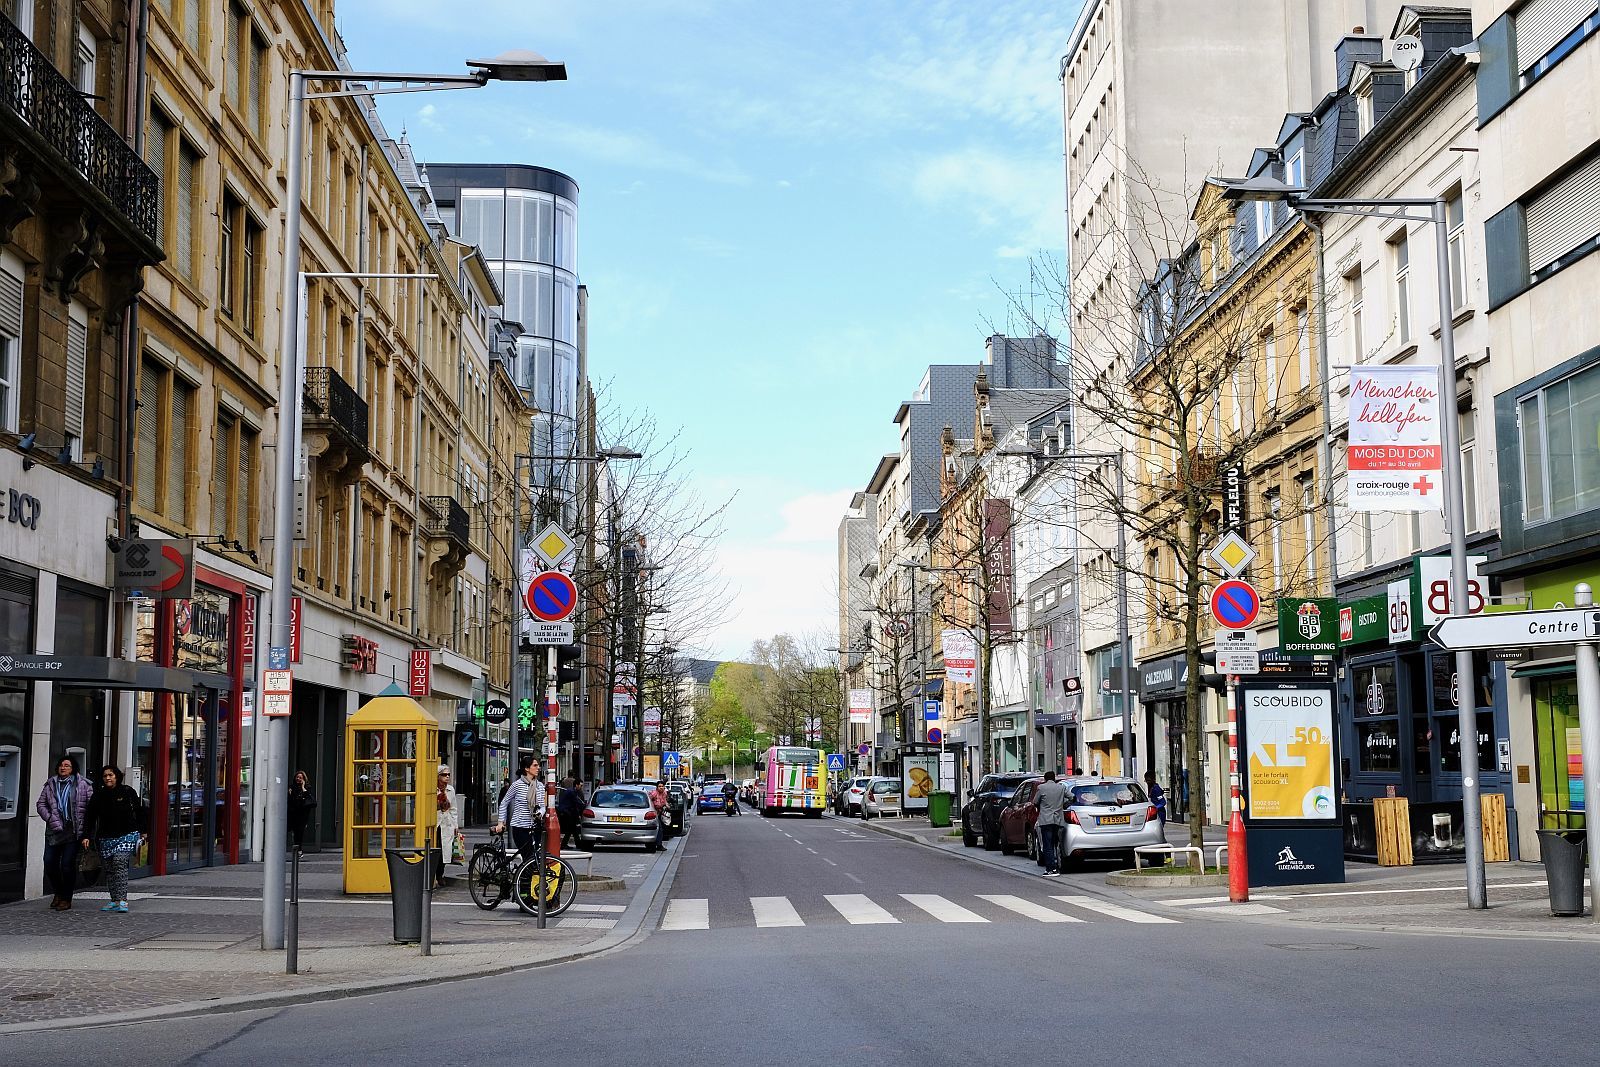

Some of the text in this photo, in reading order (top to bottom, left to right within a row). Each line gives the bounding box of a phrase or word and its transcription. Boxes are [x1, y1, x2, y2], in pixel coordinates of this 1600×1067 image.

[1351, 379, 1437, 399] Mënschen
[1357, 402, 1432, 432] hëllefen
[1354, 448, 1435, 459] MOIS DU DON
[1356, 480, 1410, 490] croix-rouge
[8, 488, 41, 530] BCP
[1358, 612, 1377, 626] BISTRO
[1529, 621, 1578, 634] Centre
[14, 661, 62, 670] BANQUE BCP
[414, 651, 426, 695] ESPRIT
[1146, 668, 1173, 686] CALZEDONIA
[1253, 696, 1323, 707] SCOUBIDO
[487, 705, 506, 714] Emo
[1367, 734, 1396, 748] Brooklyn
